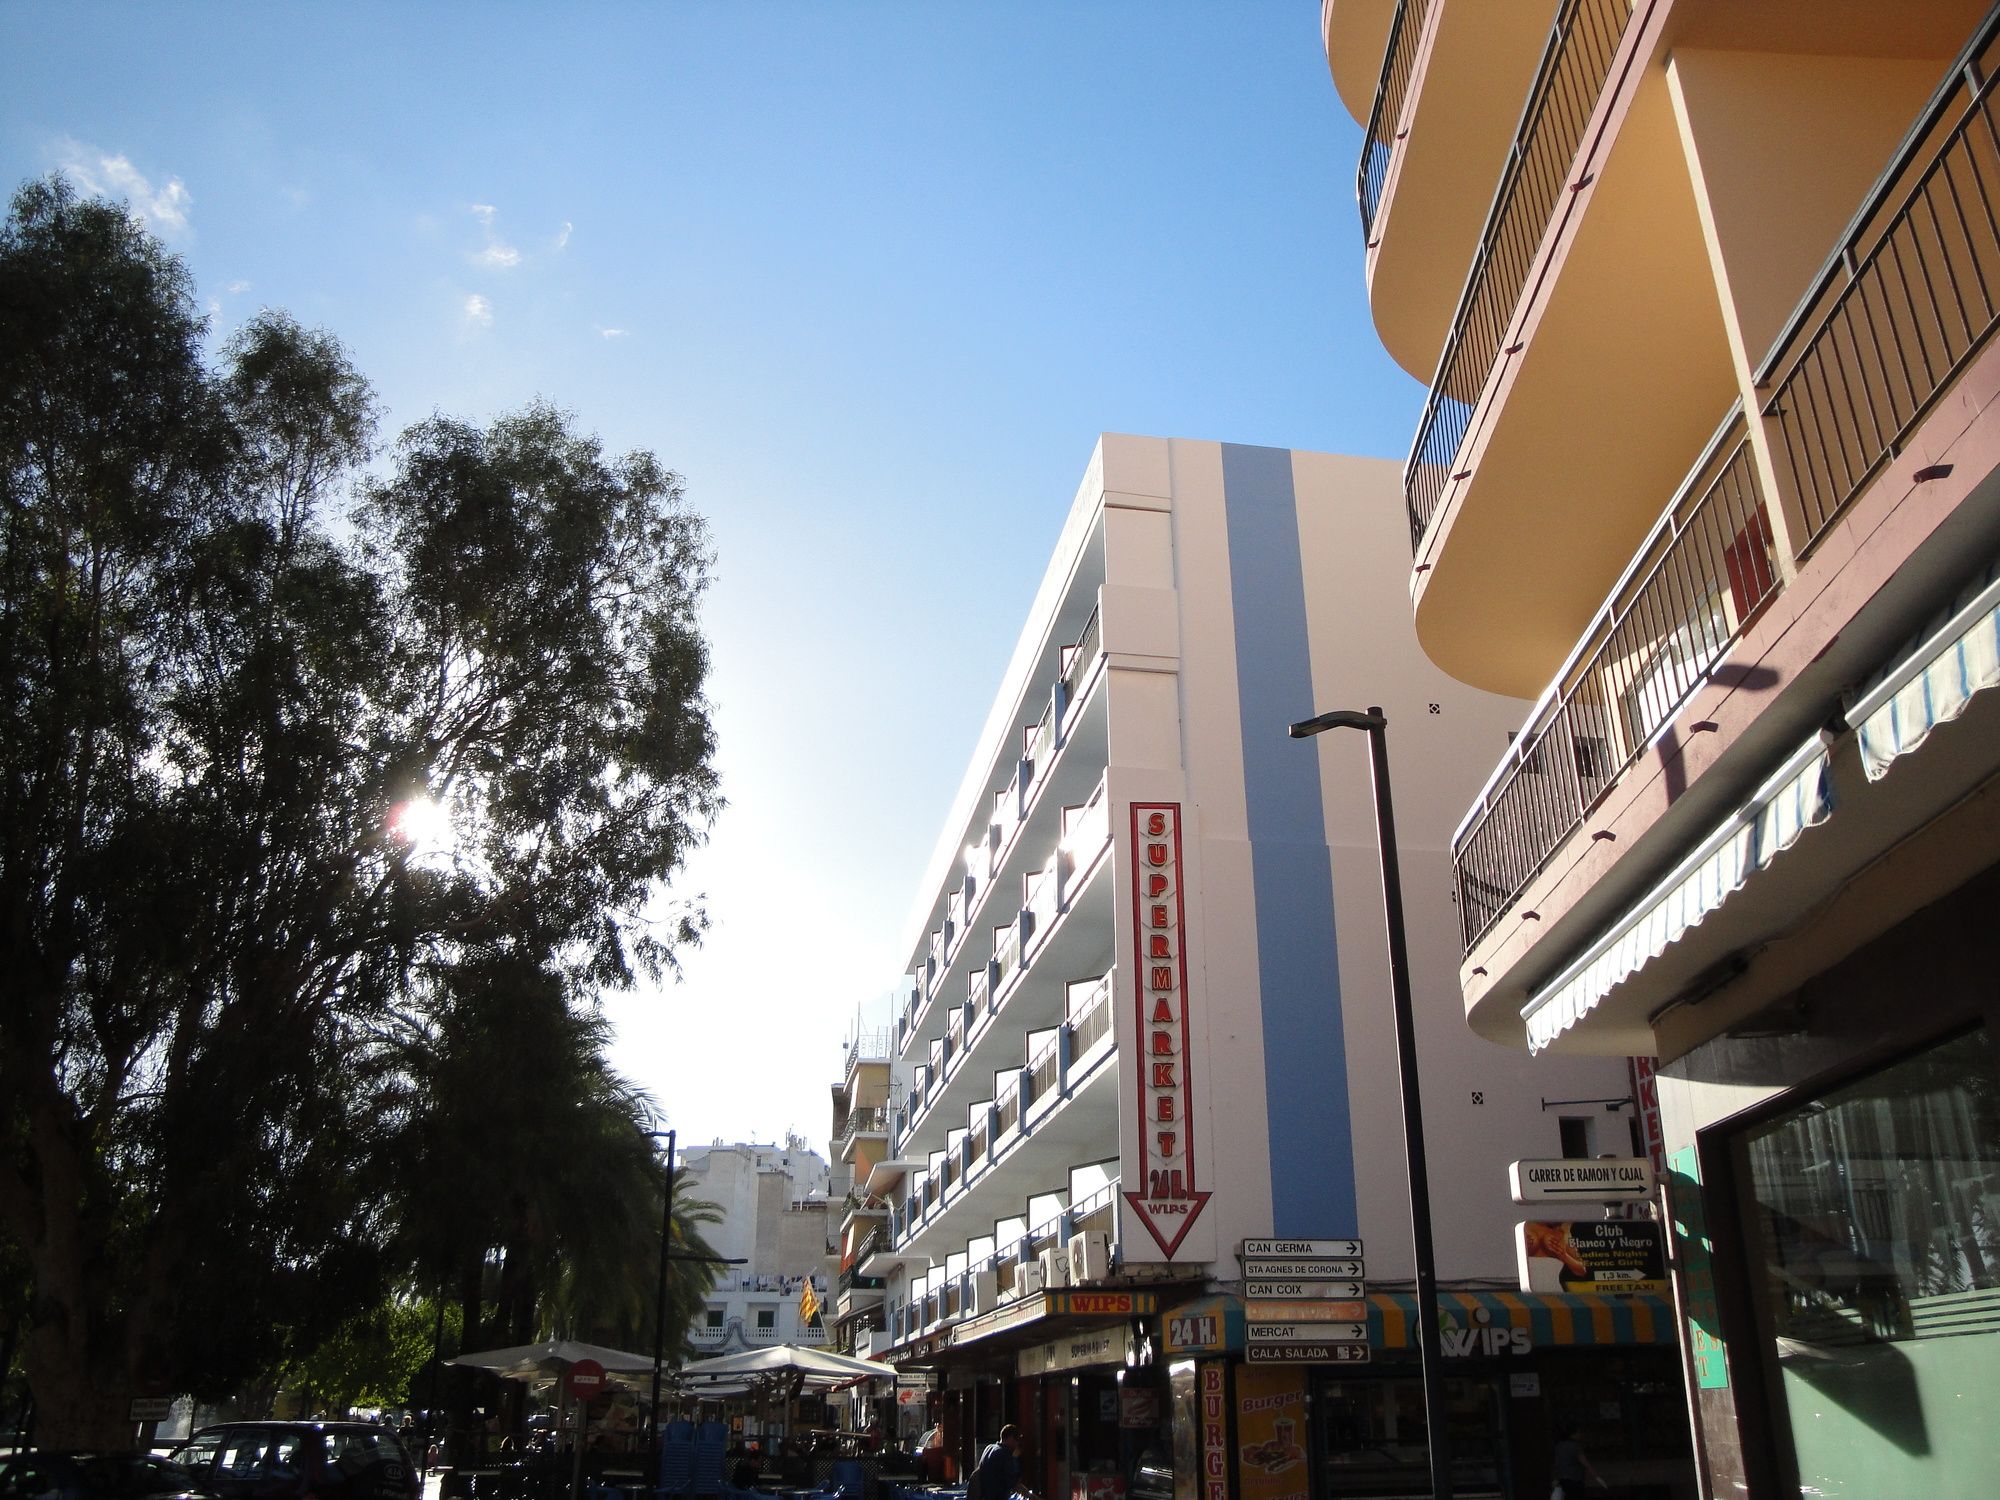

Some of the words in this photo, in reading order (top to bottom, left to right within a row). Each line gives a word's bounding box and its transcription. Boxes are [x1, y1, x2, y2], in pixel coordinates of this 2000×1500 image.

[1147, 812, 1176, 1158] SUPERMARKET
[1528, 1168, 1562, 1183] CARRER
[1563, 1168, 1575, 1182] DE
[1577, 1167, 1610, 1182] RAMON
[1611, 1167, 1617, 1181] Y
[1619, 1167, 1645, 1181] CAJAL
[1147, 1203, 1189, 1215] WIPS
[1595, 1224, 1624, 1237] Club
[1248, 1244, 1271, 1253] CAN
[1275, 1244, 1313, 1253] GERMA
[1568, 1236, 1607, 1249] Blanco
[1608, 1239, 1616, 1249] y
[1619, 1236, 1653, 1249] Negro
[1583, 1259, 1615, 1267] Erotic
[1248, 1266, 1263, 1274] STA
[1265, 1266, 1293, 1274] AGNES
[1249, 1285, 1272, 1294] CAN
[1276, 1285, 1302, 1294] COIX
[1596, 1284, 1625, 1292] FREE
[1628, 1283, 1655, 1291] TAXI
[1071, 1295, 1131, 1312] WIPS
[1171, 1319, 1194, 1346] 24
[1251, 1327, 1295, 1337] MERCAT
[1251, 1349, 1281, 1358] CALA
[1285, 1348, 1329, 1358] SALADA
[1242, 1389, 1304, 1413] Burger
